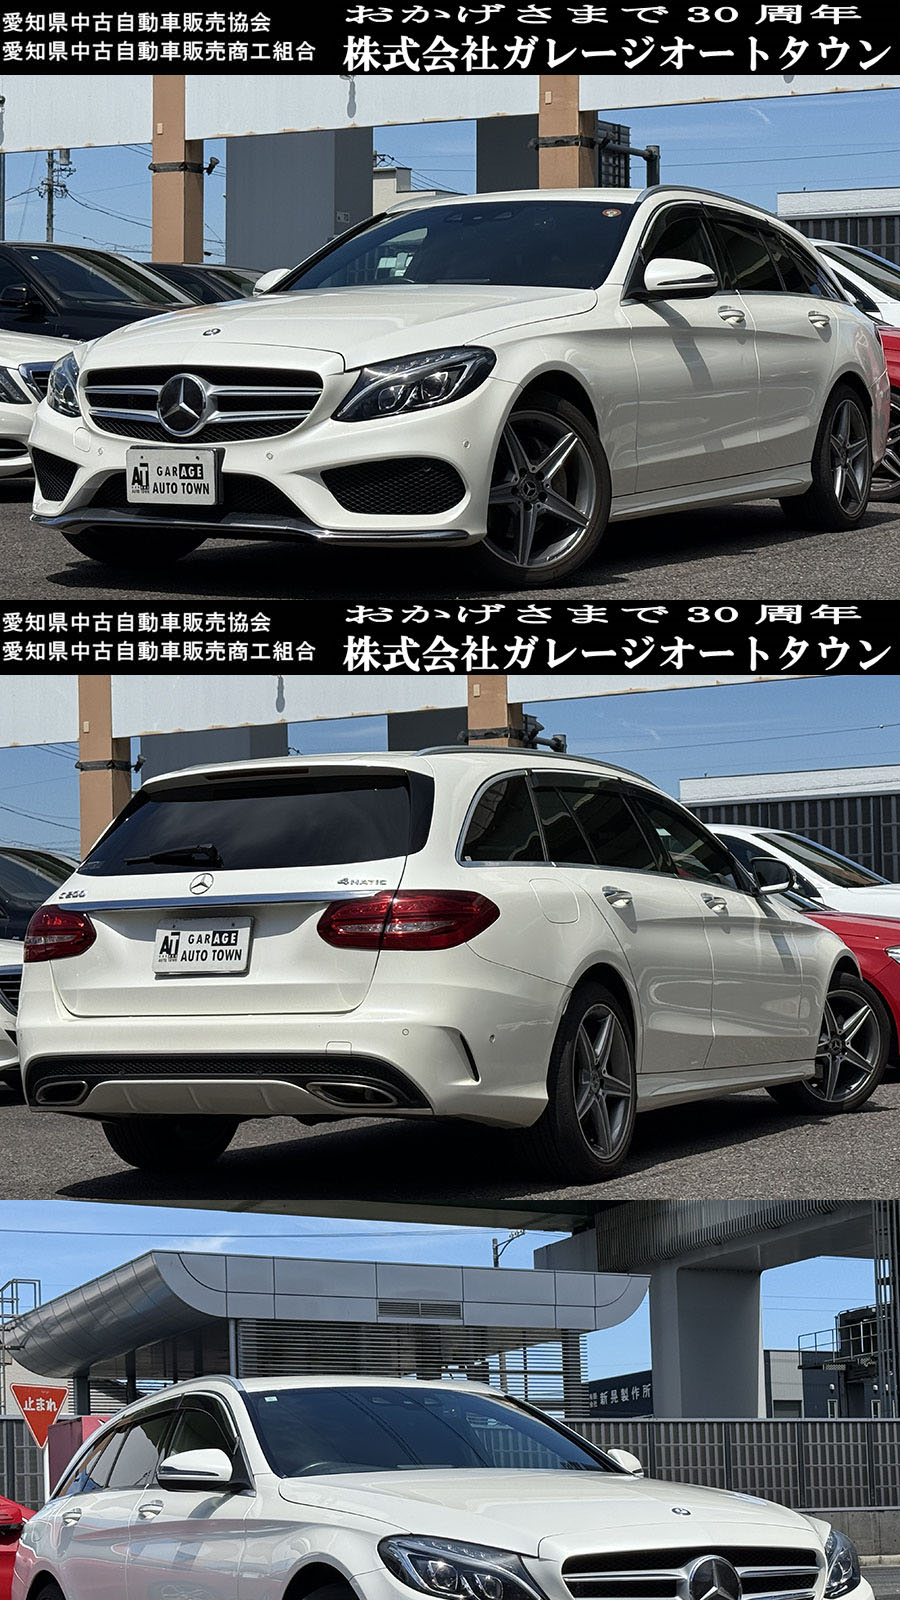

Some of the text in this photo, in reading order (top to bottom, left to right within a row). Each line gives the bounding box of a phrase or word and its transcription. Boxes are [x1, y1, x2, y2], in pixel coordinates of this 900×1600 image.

[156, 465, 203, 478] GARAGE
[152, 482, 178, 494] AUTO
[181, 482, 210, 495] TOWN
[187, 932, 238, 945] GARAGE
[180, 950, 208, 962] AUTO
[212, 949, 242, 962] TOWN
[23, 1396, 58, 1412] 止まれ
